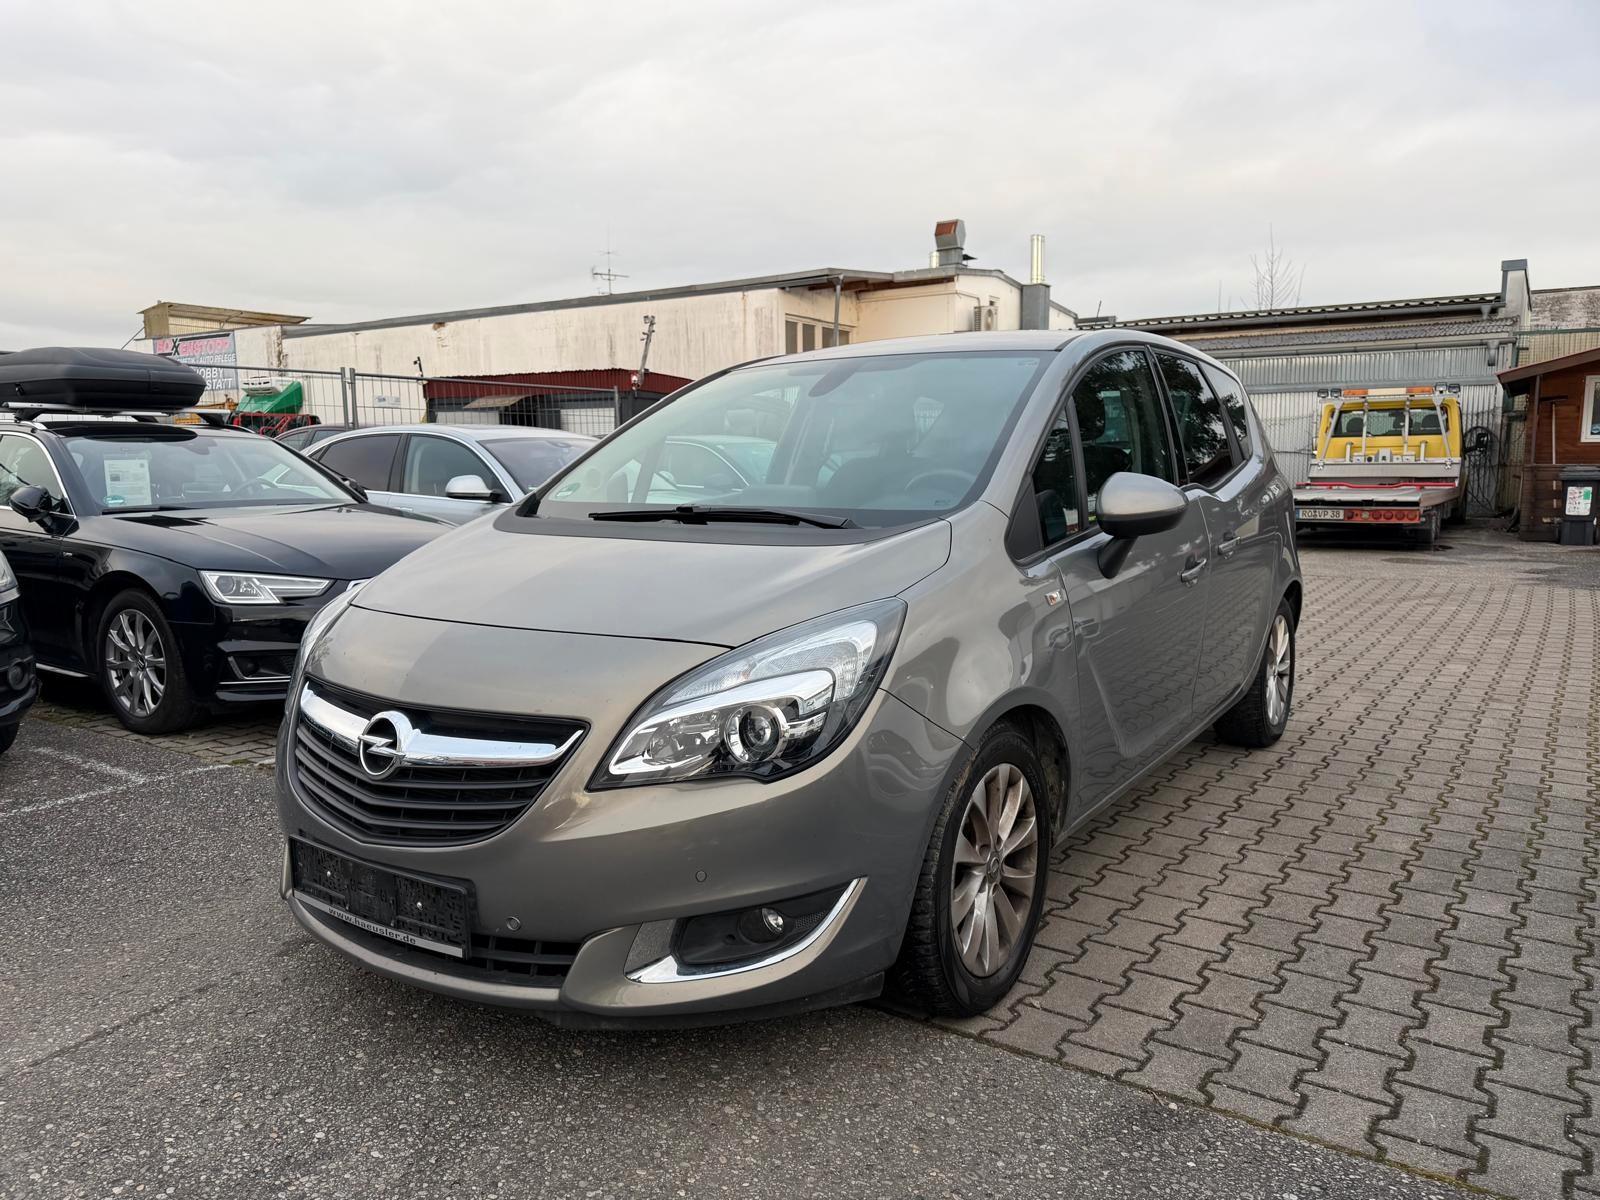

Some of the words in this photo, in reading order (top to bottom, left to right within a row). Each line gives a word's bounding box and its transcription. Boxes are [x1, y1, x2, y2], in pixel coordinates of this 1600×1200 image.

[214, 353, 236, 363] PFLEGE
[1302, 510, 1313, 518] RO
[1318, 510, 1329, 518] VP
[1330, 510, 1341, 518] 38
[328, 906, 416, 945] www.haeusler.de
